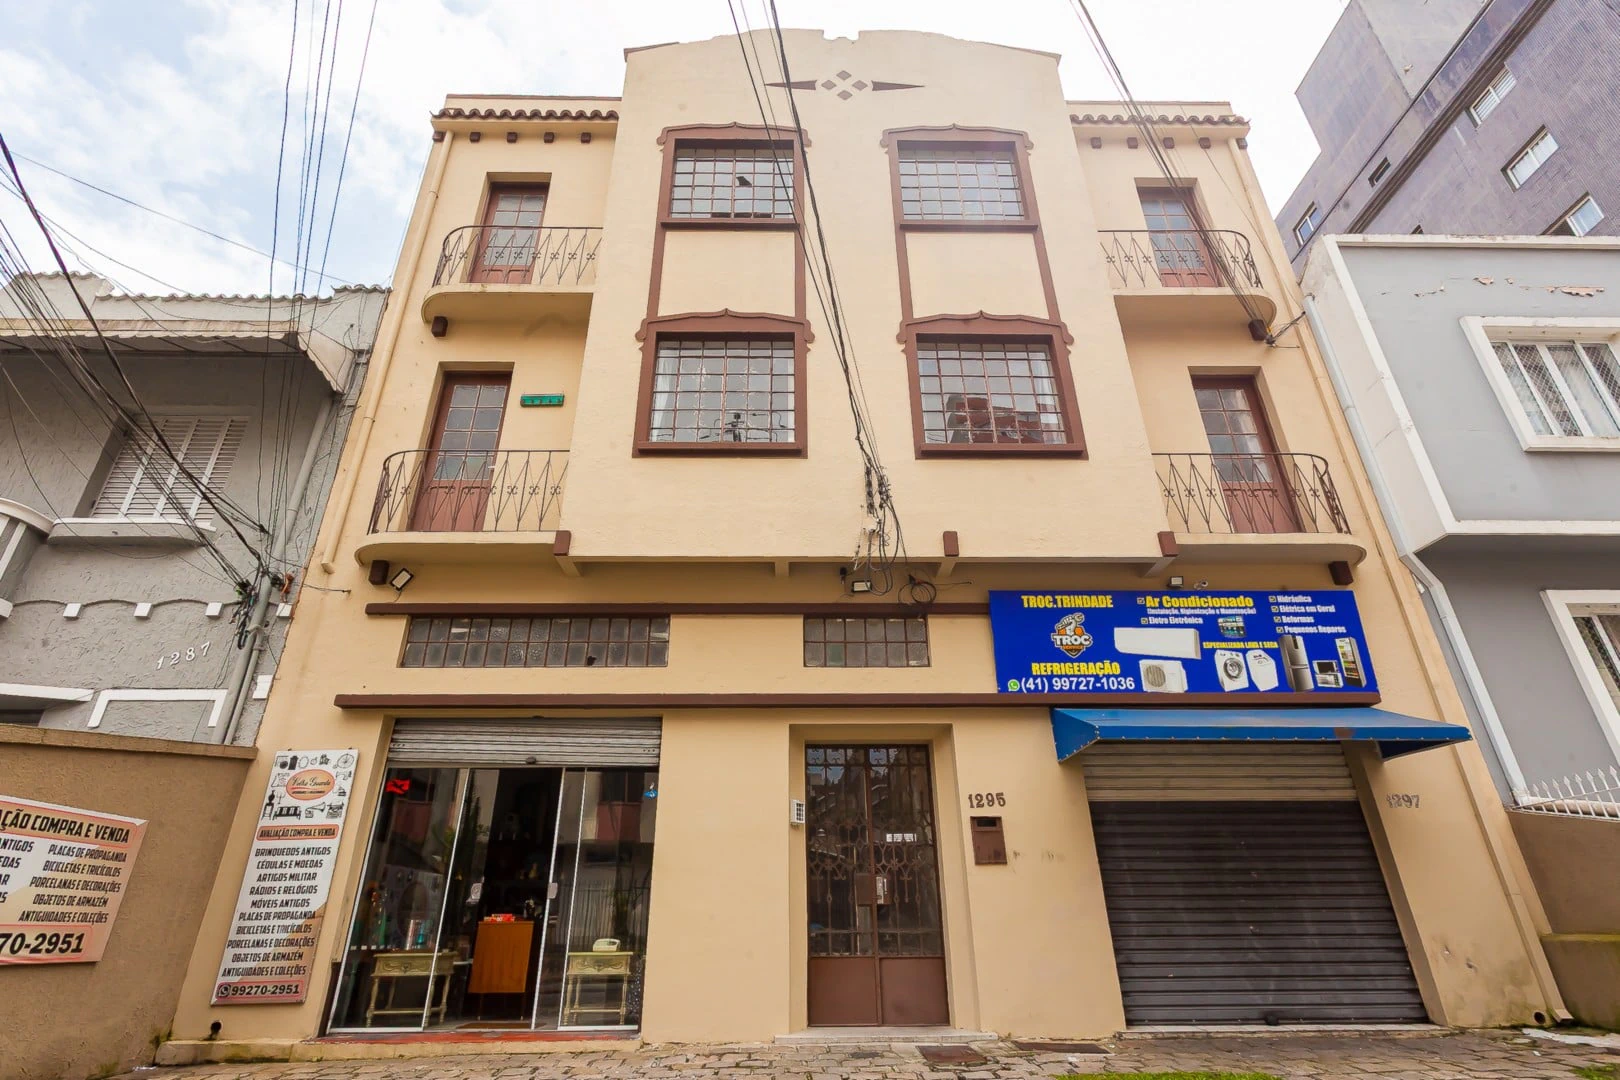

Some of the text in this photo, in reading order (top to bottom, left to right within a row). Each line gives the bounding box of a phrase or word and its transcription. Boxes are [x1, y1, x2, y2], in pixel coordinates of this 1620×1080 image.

[1021, 595, 1114, 609] TROC.TRINDADE
[1145, 595, 1254, 608] Ar Condicionado
[1053, 635, 1091, 646] TROC
[157, 641, 210, 670] 1287
[1031, 660, 1120, 676] REFRIGERAÇÃO
[1021, 677, 1135, 694] (41) 99727-1036
[968, 792, 1006, 808] 1295
[1386, 793, 1420, 808] 1297
[31, 814, 81, 837] COMPRA
[84, 823, 94, 838] E
[94, 824, 130, 843] VENDA
[259, 828, 336, 839] AVALIAÇÃO COMPRA E VENDA
[0, 837, 35, 852] NTIGOS
[48, 844, 127, 862] PLACAS DE PROPAGANDA
[255, 847, 332, 857] BRINQUEDOS ANTIGOS
[43, 860, 81, 874] BICICLETAS
[80, 864, 86, 874] E
[256, 859, 324, 869] CÉDULAS E MOEDAS
[256, 872, 317, 882] ARTIGOS MILITAR
[29, 876, 122, 894] PORCELANAS E DECORAÇÕES
[249, 884, 318, 895] RÁDIOS E RELÓGIOS
[32, 894, 109, 907] OBJETOS DE ARMAZÉM
[250, 898, 310, 908] MÓVEIS ANTIGOS
[18, 910, 109, 925] ANTIGUIDADES E COLEÇÕES
[238, 911, 316, 921] PLACAS DE PROPAGANDA
[236, 925, 271, 935] BICICLETAS
[271, 925, 276, 934] E
[0, 933, 85, 955] 70-2951
[227, 936, 315, 949] PORCELANAS E DECORAÇÕES
[231, 950, 304, 963] OBJETOS DE ARMAZÉM
[222, 964, 307, 977] ANTIGUIDADES E COLEÇÕES
[231, 984, 300, 996] 99270-2951
